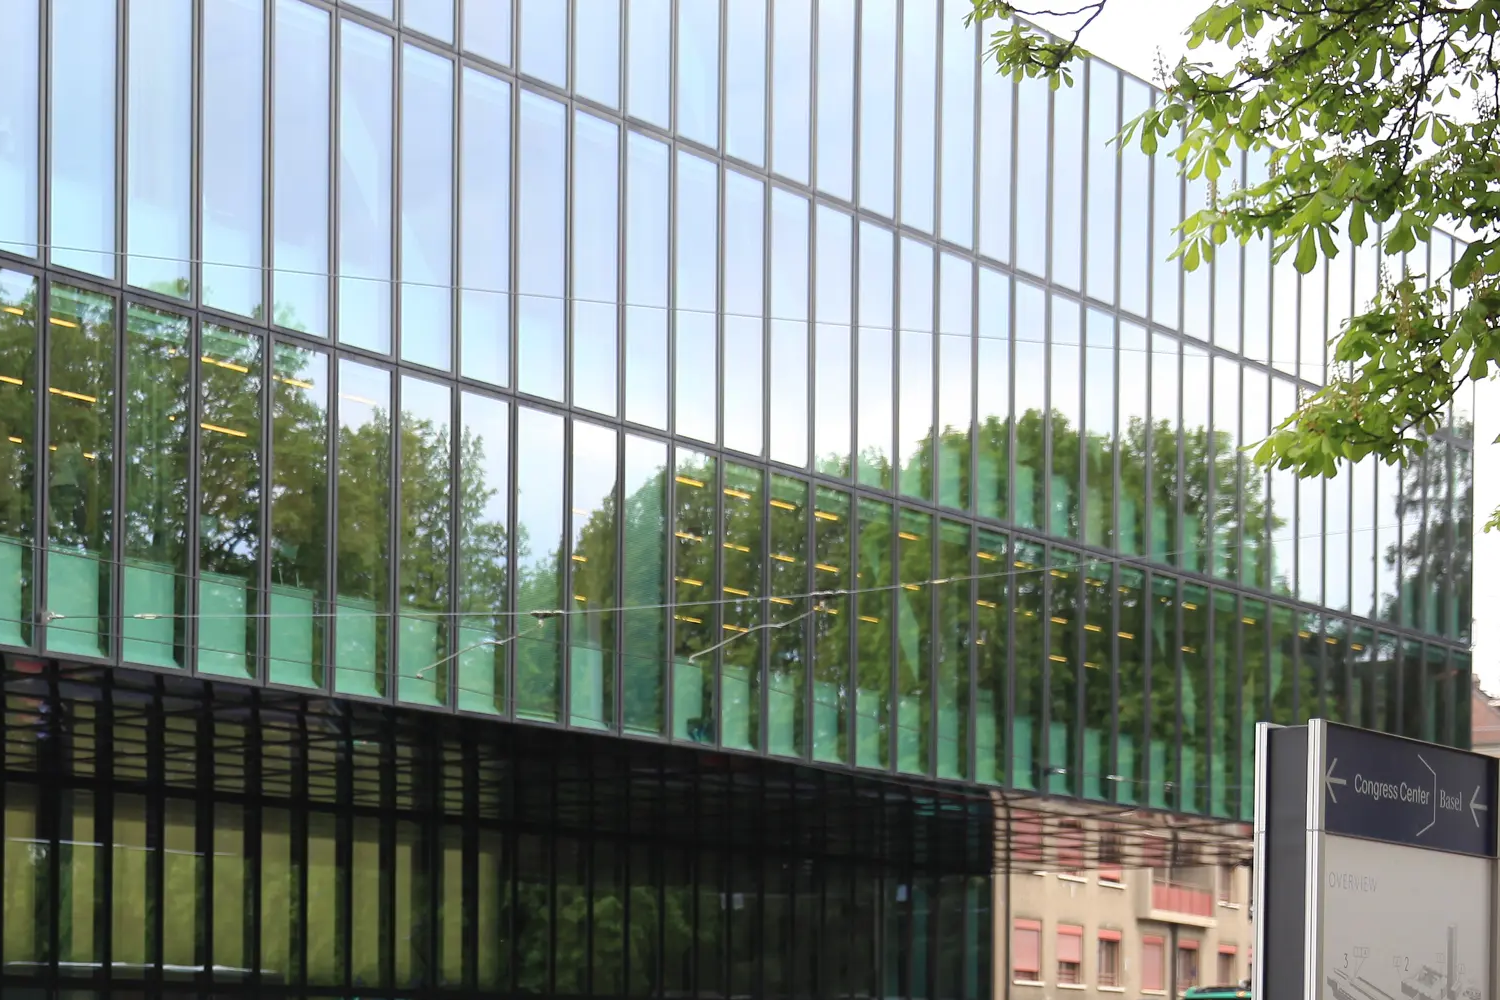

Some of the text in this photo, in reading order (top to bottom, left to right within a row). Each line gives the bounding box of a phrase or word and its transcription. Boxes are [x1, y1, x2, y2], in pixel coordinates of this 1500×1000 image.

[1354, 774, 1462, 812] Congress Center Basel
[1328, 870, 1378, 892] OVERVIEW
[1342, 953, 1349, 969] 3
[1403, 956, 1410, 972] 2
